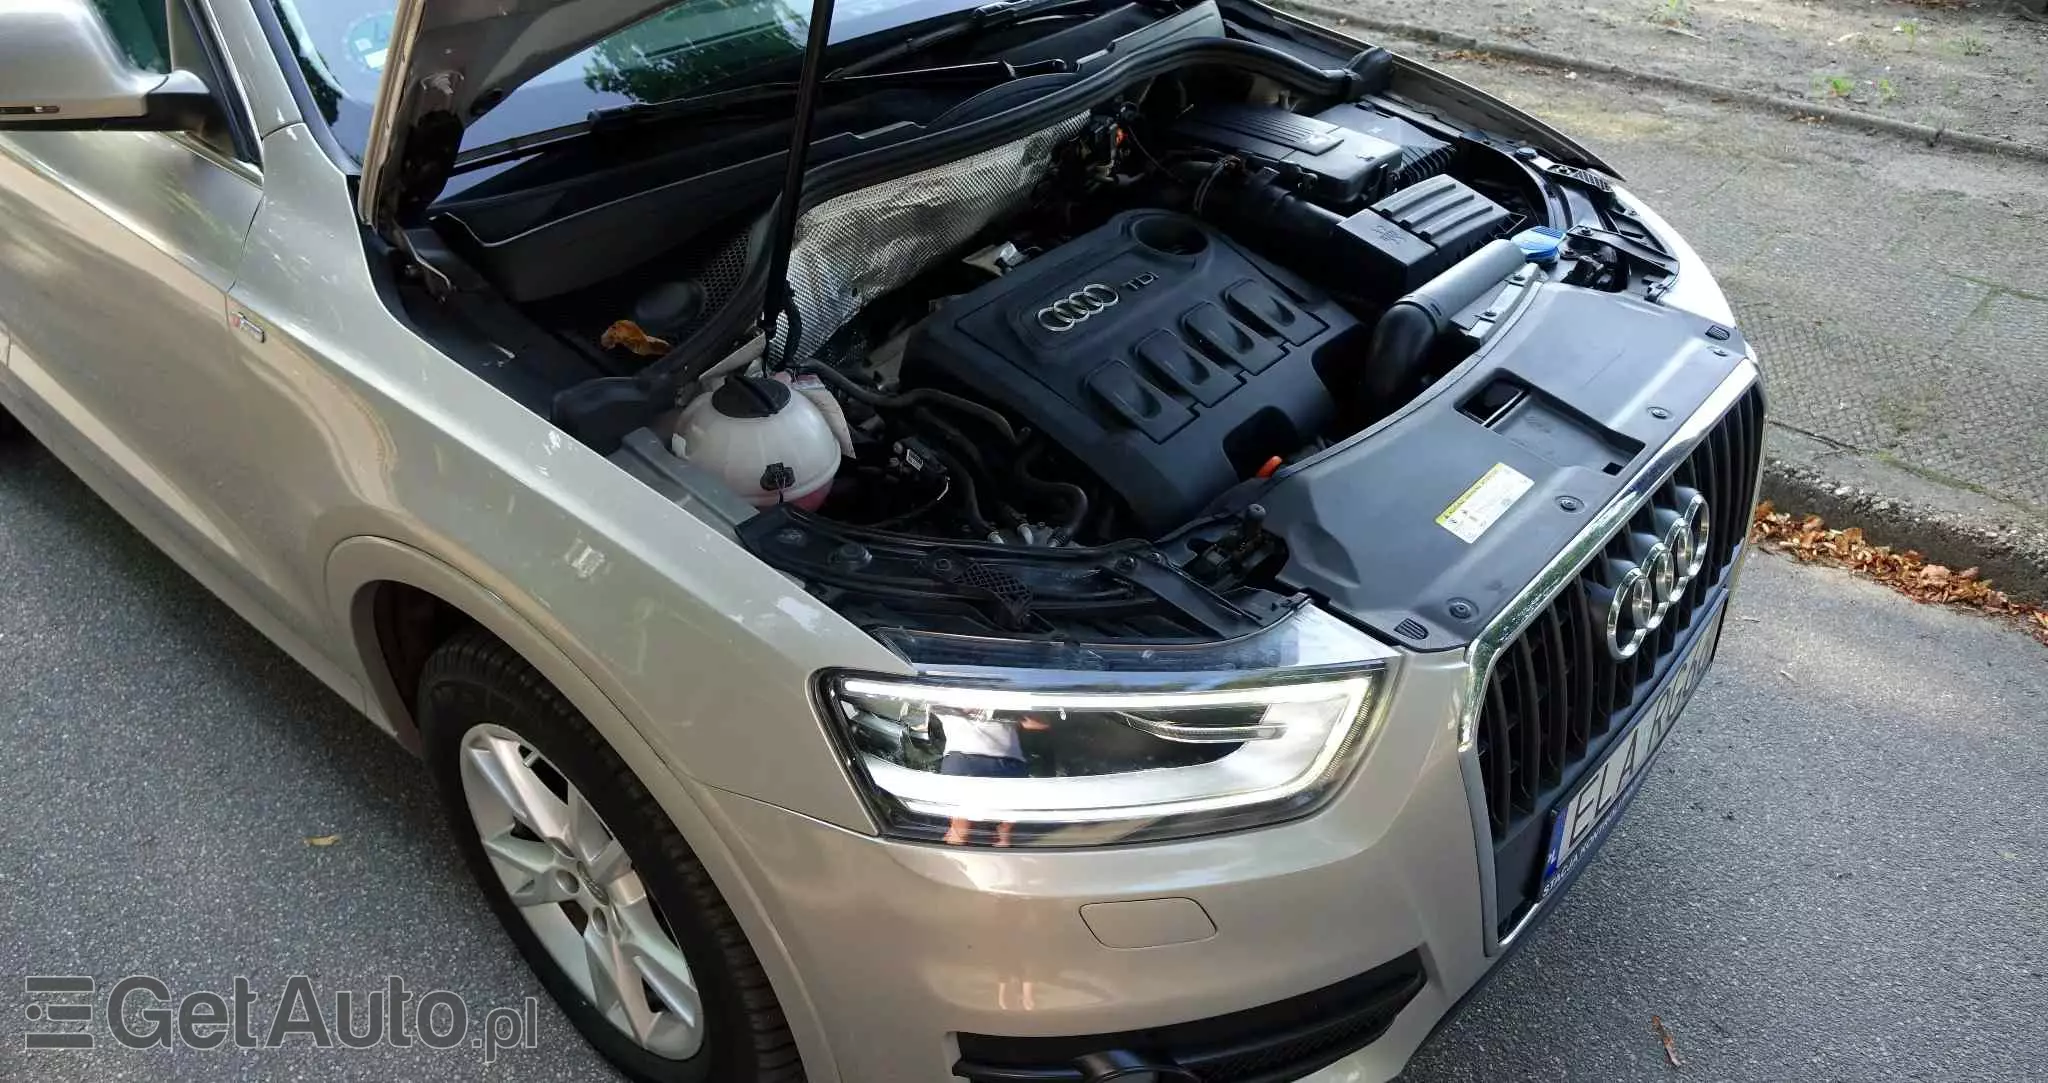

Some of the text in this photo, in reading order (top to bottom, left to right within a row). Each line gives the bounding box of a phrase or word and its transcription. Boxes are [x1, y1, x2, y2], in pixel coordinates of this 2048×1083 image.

[1121, 271, 1159, 291] TDI
[1567, 727, 1638, 849] ELA
[1542, 853, 1579, 898] STACJA
